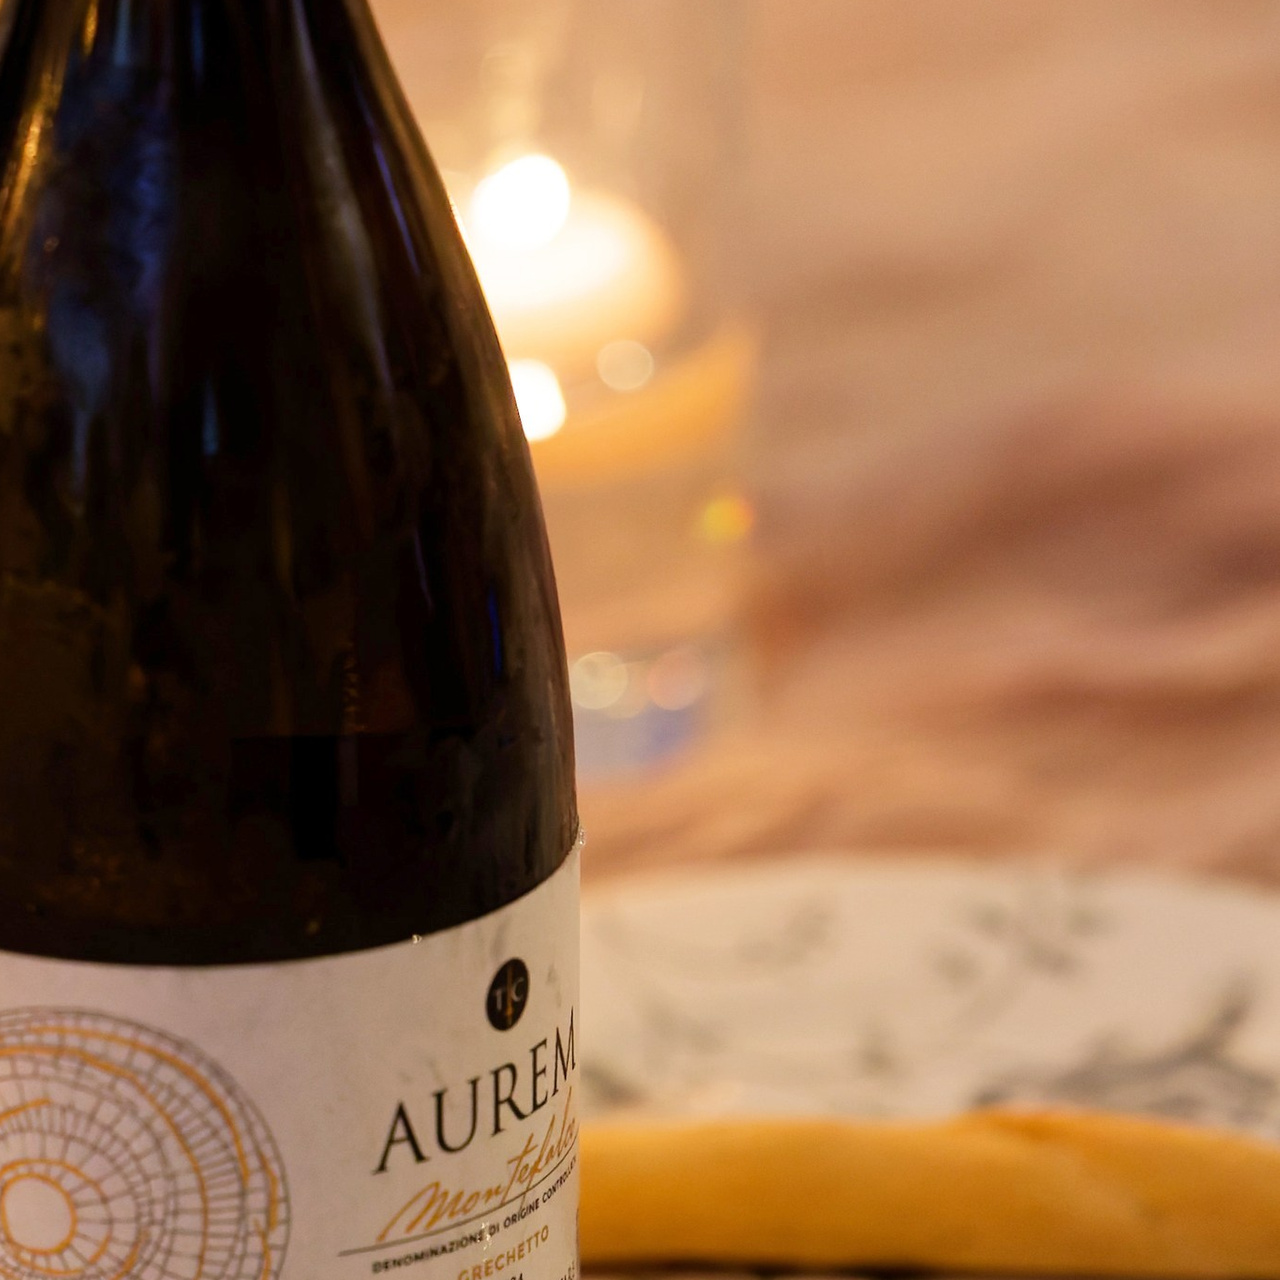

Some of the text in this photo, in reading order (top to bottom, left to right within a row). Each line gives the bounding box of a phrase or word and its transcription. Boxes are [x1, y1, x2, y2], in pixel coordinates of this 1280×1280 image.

[371, 1230, 485, 1274] DENOMINAZIONE
[488, 1221, 501, 1237] DI
[503, 1198, 541, 1230] ORIGINE
